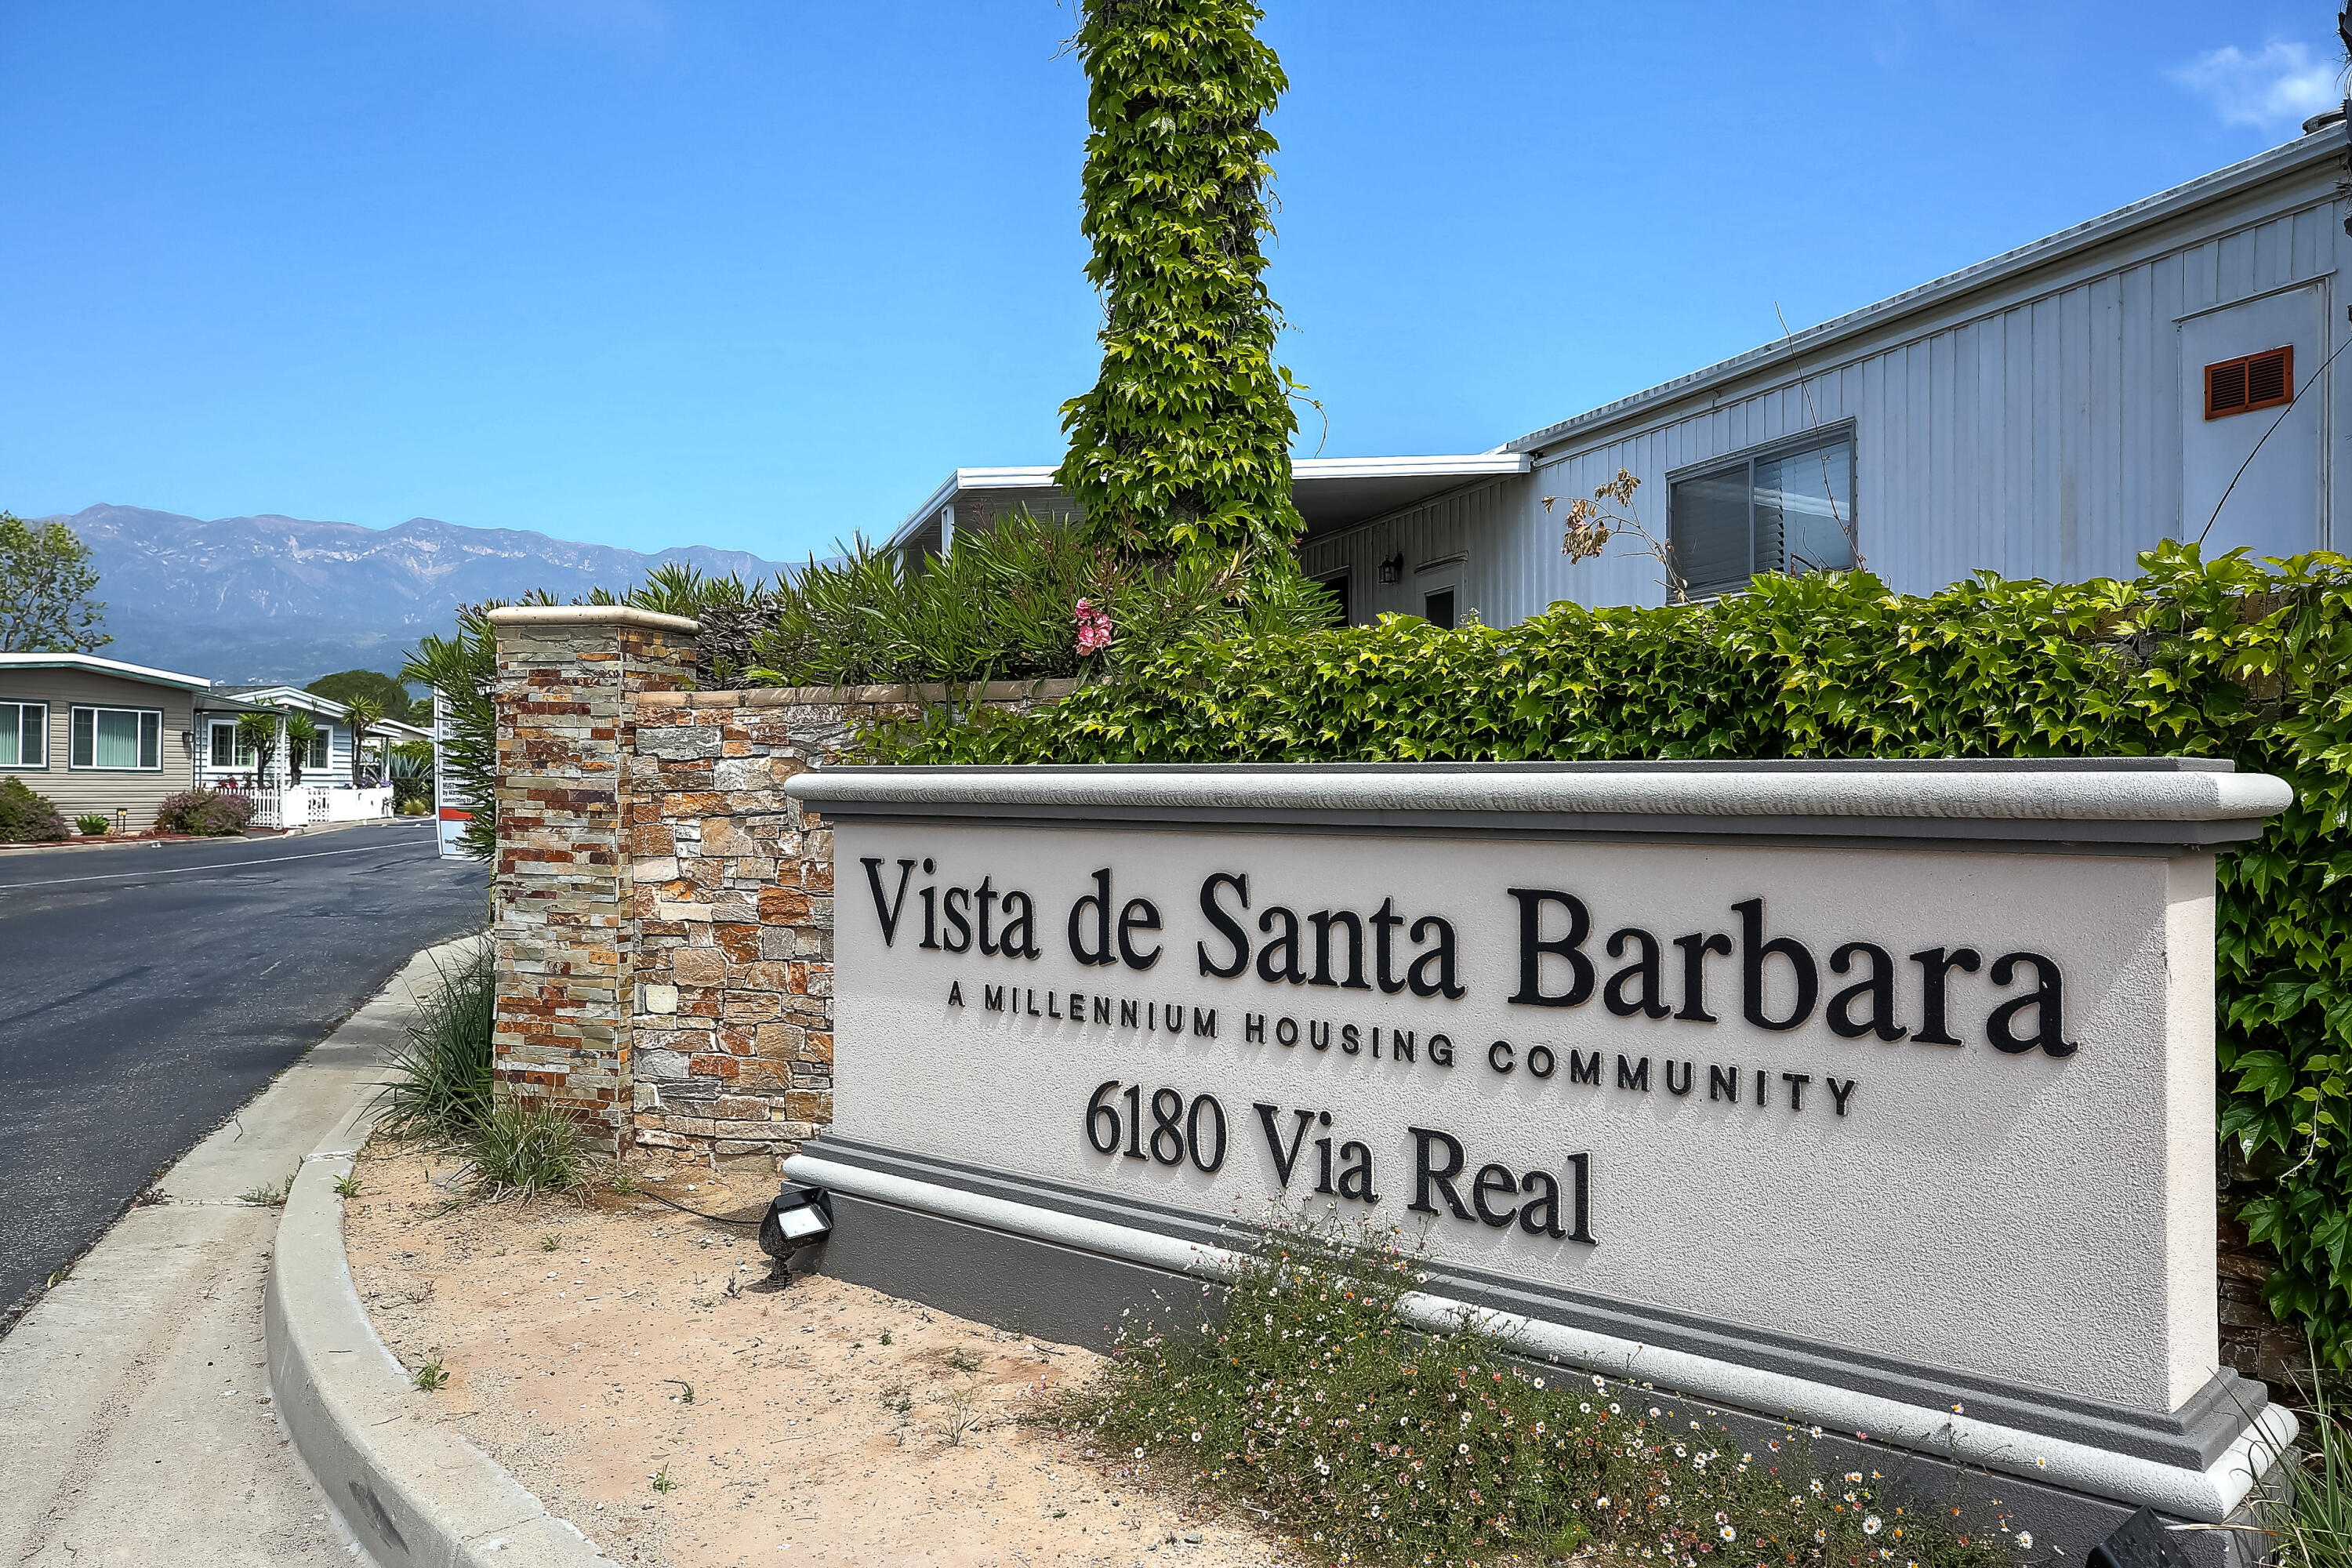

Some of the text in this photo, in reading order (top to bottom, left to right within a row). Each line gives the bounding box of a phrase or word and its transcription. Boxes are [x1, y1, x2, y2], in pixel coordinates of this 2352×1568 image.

[859, 857, 2079, 1059] Vista de Santa Barbara
[948, 980, 1857, 1117] A MILLENNIUM HOUSING COMMUNITY
[1086, 1080, 1599, 1247] 6180 Via Real
